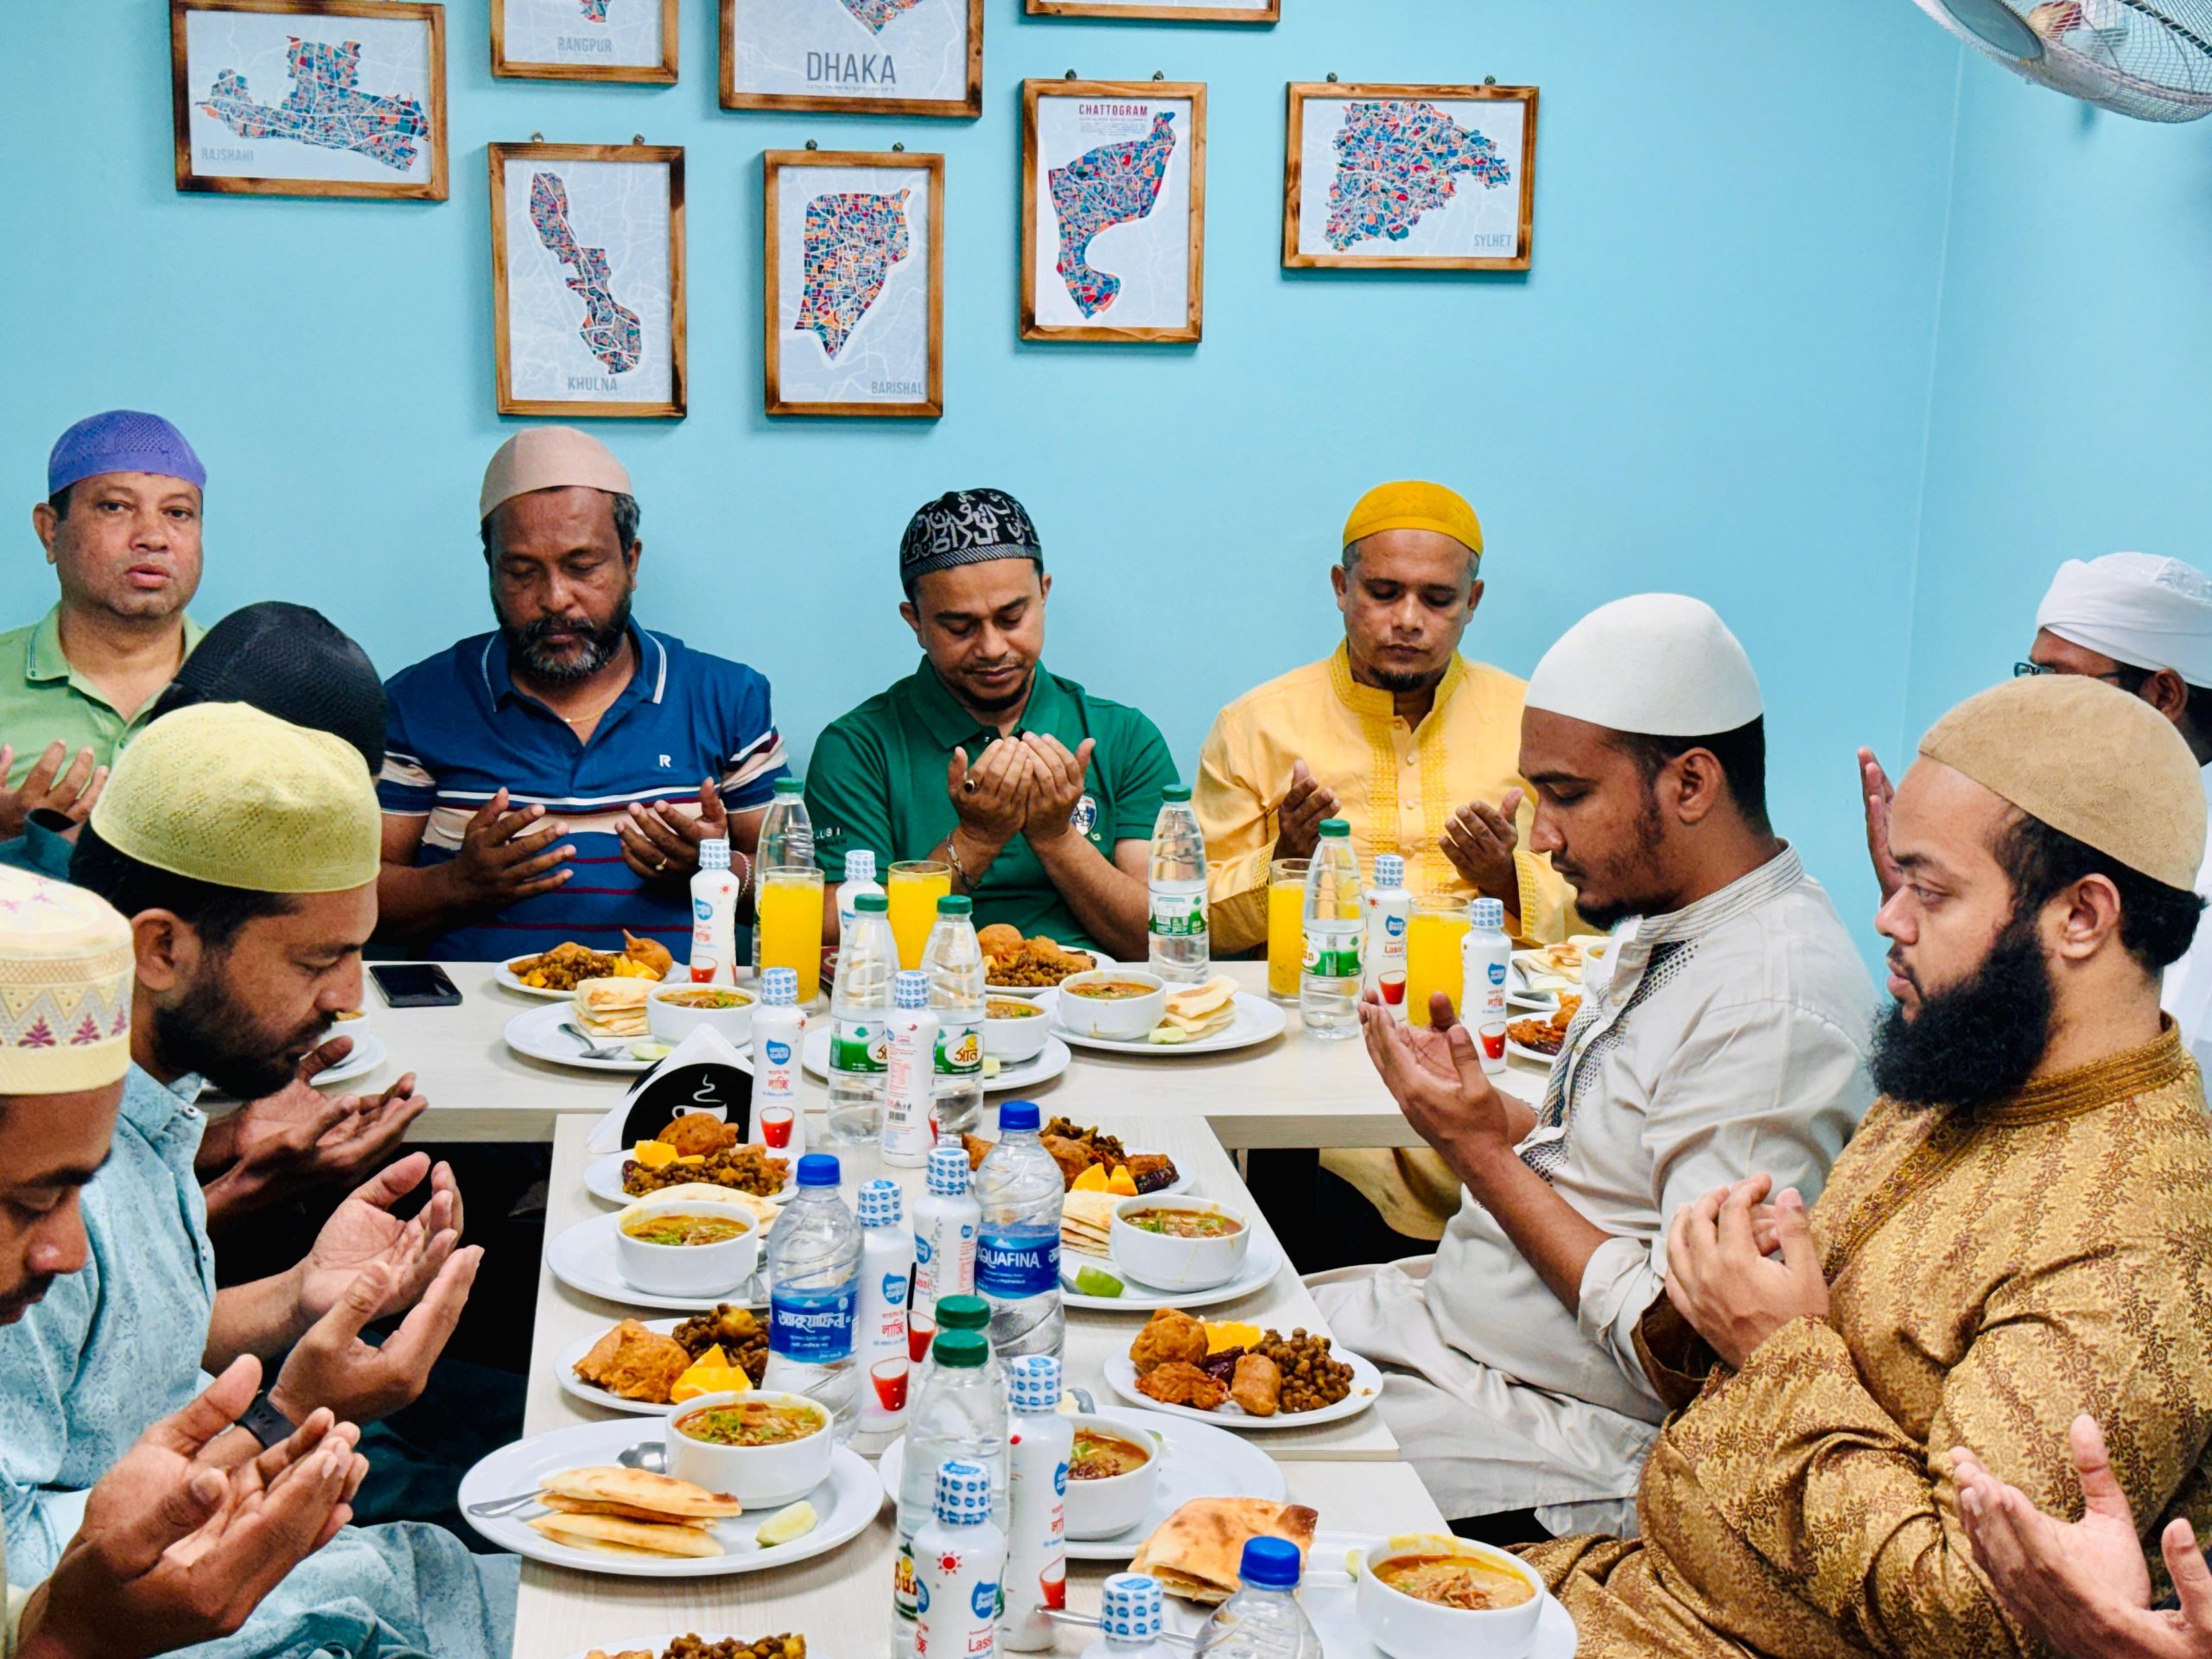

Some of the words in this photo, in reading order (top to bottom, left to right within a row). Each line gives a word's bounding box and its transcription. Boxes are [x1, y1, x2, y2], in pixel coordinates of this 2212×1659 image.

[557, 36, 612, 53] RANGPUR
[807, 52, 896, 84] DHAKA
[1078, 105, 1147, 116] CHATTOGRAM
[201, 147, 254, 162] RAJSHAHI
[1473, 233, 1512, 247] SYLHET
[568, 376, 617, 391] KHULNA
[871, 381, 924, 395] BARISHAL
[659, 754, 671, 767] R
[954, 1046, 978, 1062] সান
[968, 1635, 993, 1652] Lass
